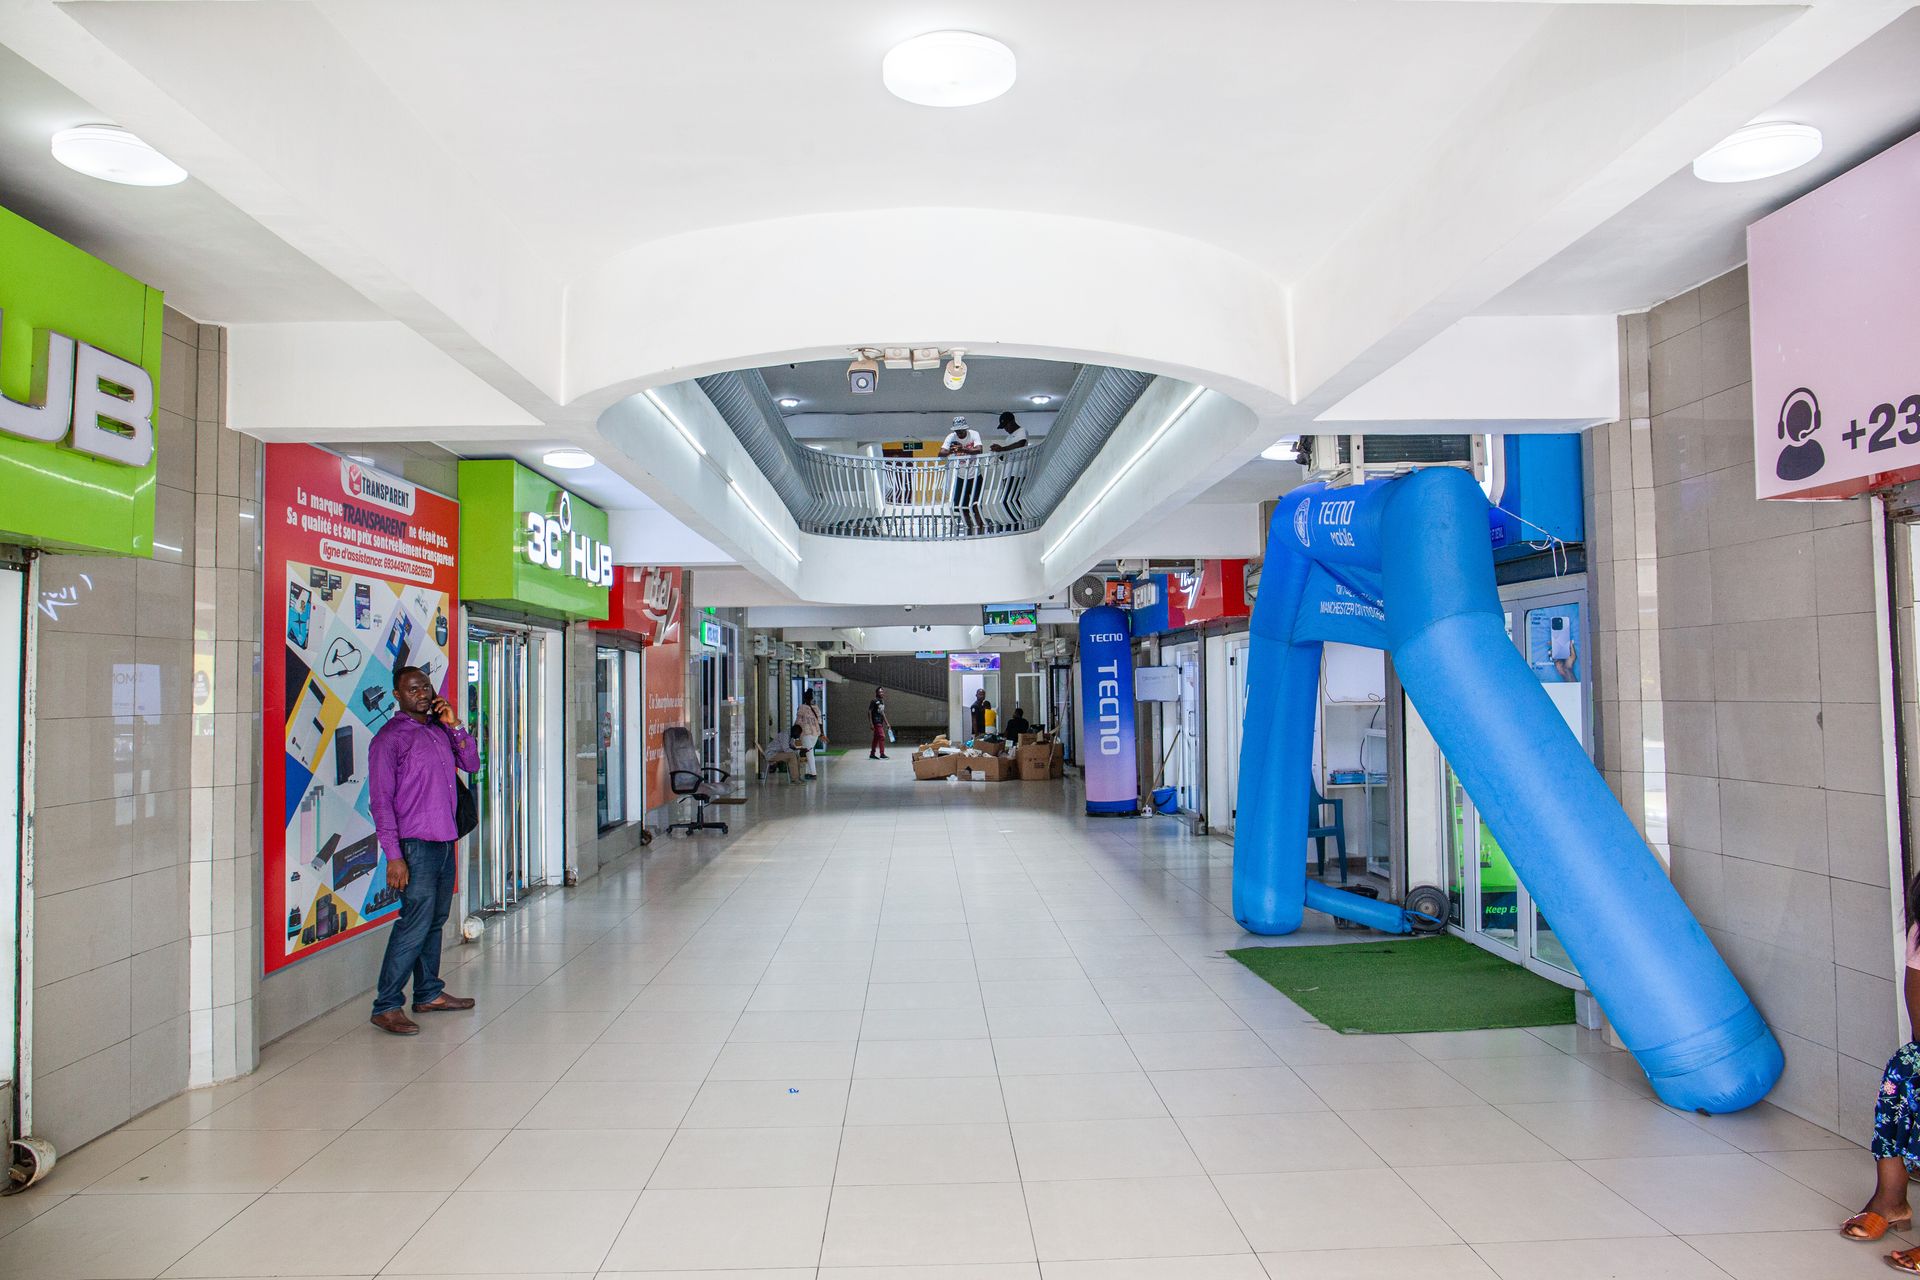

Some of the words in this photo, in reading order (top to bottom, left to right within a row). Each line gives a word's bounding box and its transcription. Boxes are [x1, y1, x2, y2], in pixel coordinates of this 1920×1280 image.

[1842, 394, 1920, 453] +23
[297, 486, 307, 506] La
[310, 494, 343, 517] marque
[342, 502, 407, 539] TRANSPARENT
[408, 525, 417, 539] ne
[362, 476, 409, 509] TRANSPARENT
[1318, 500, 1356, 526] TECNO
[286, 506, 298, 526] Sa
[301, 514, 332, 535] qualité
[333, 522, 342, 538] et
[342, 526, 357, 542] son
[357, 530, 372, 546] prix
[373, 534, 388, 550] sont
[422, 545, 455, 568] transparent
[322, 541, 341, 560] ligne
[527, 511, 562, 570] 3C
[570, 530, 613, 587] HUB
[1089, 632, 1124, 643] TECNO
[1097, 659, 1121, 755] TECNO
[1485, 905, 1508, 915] Keep
